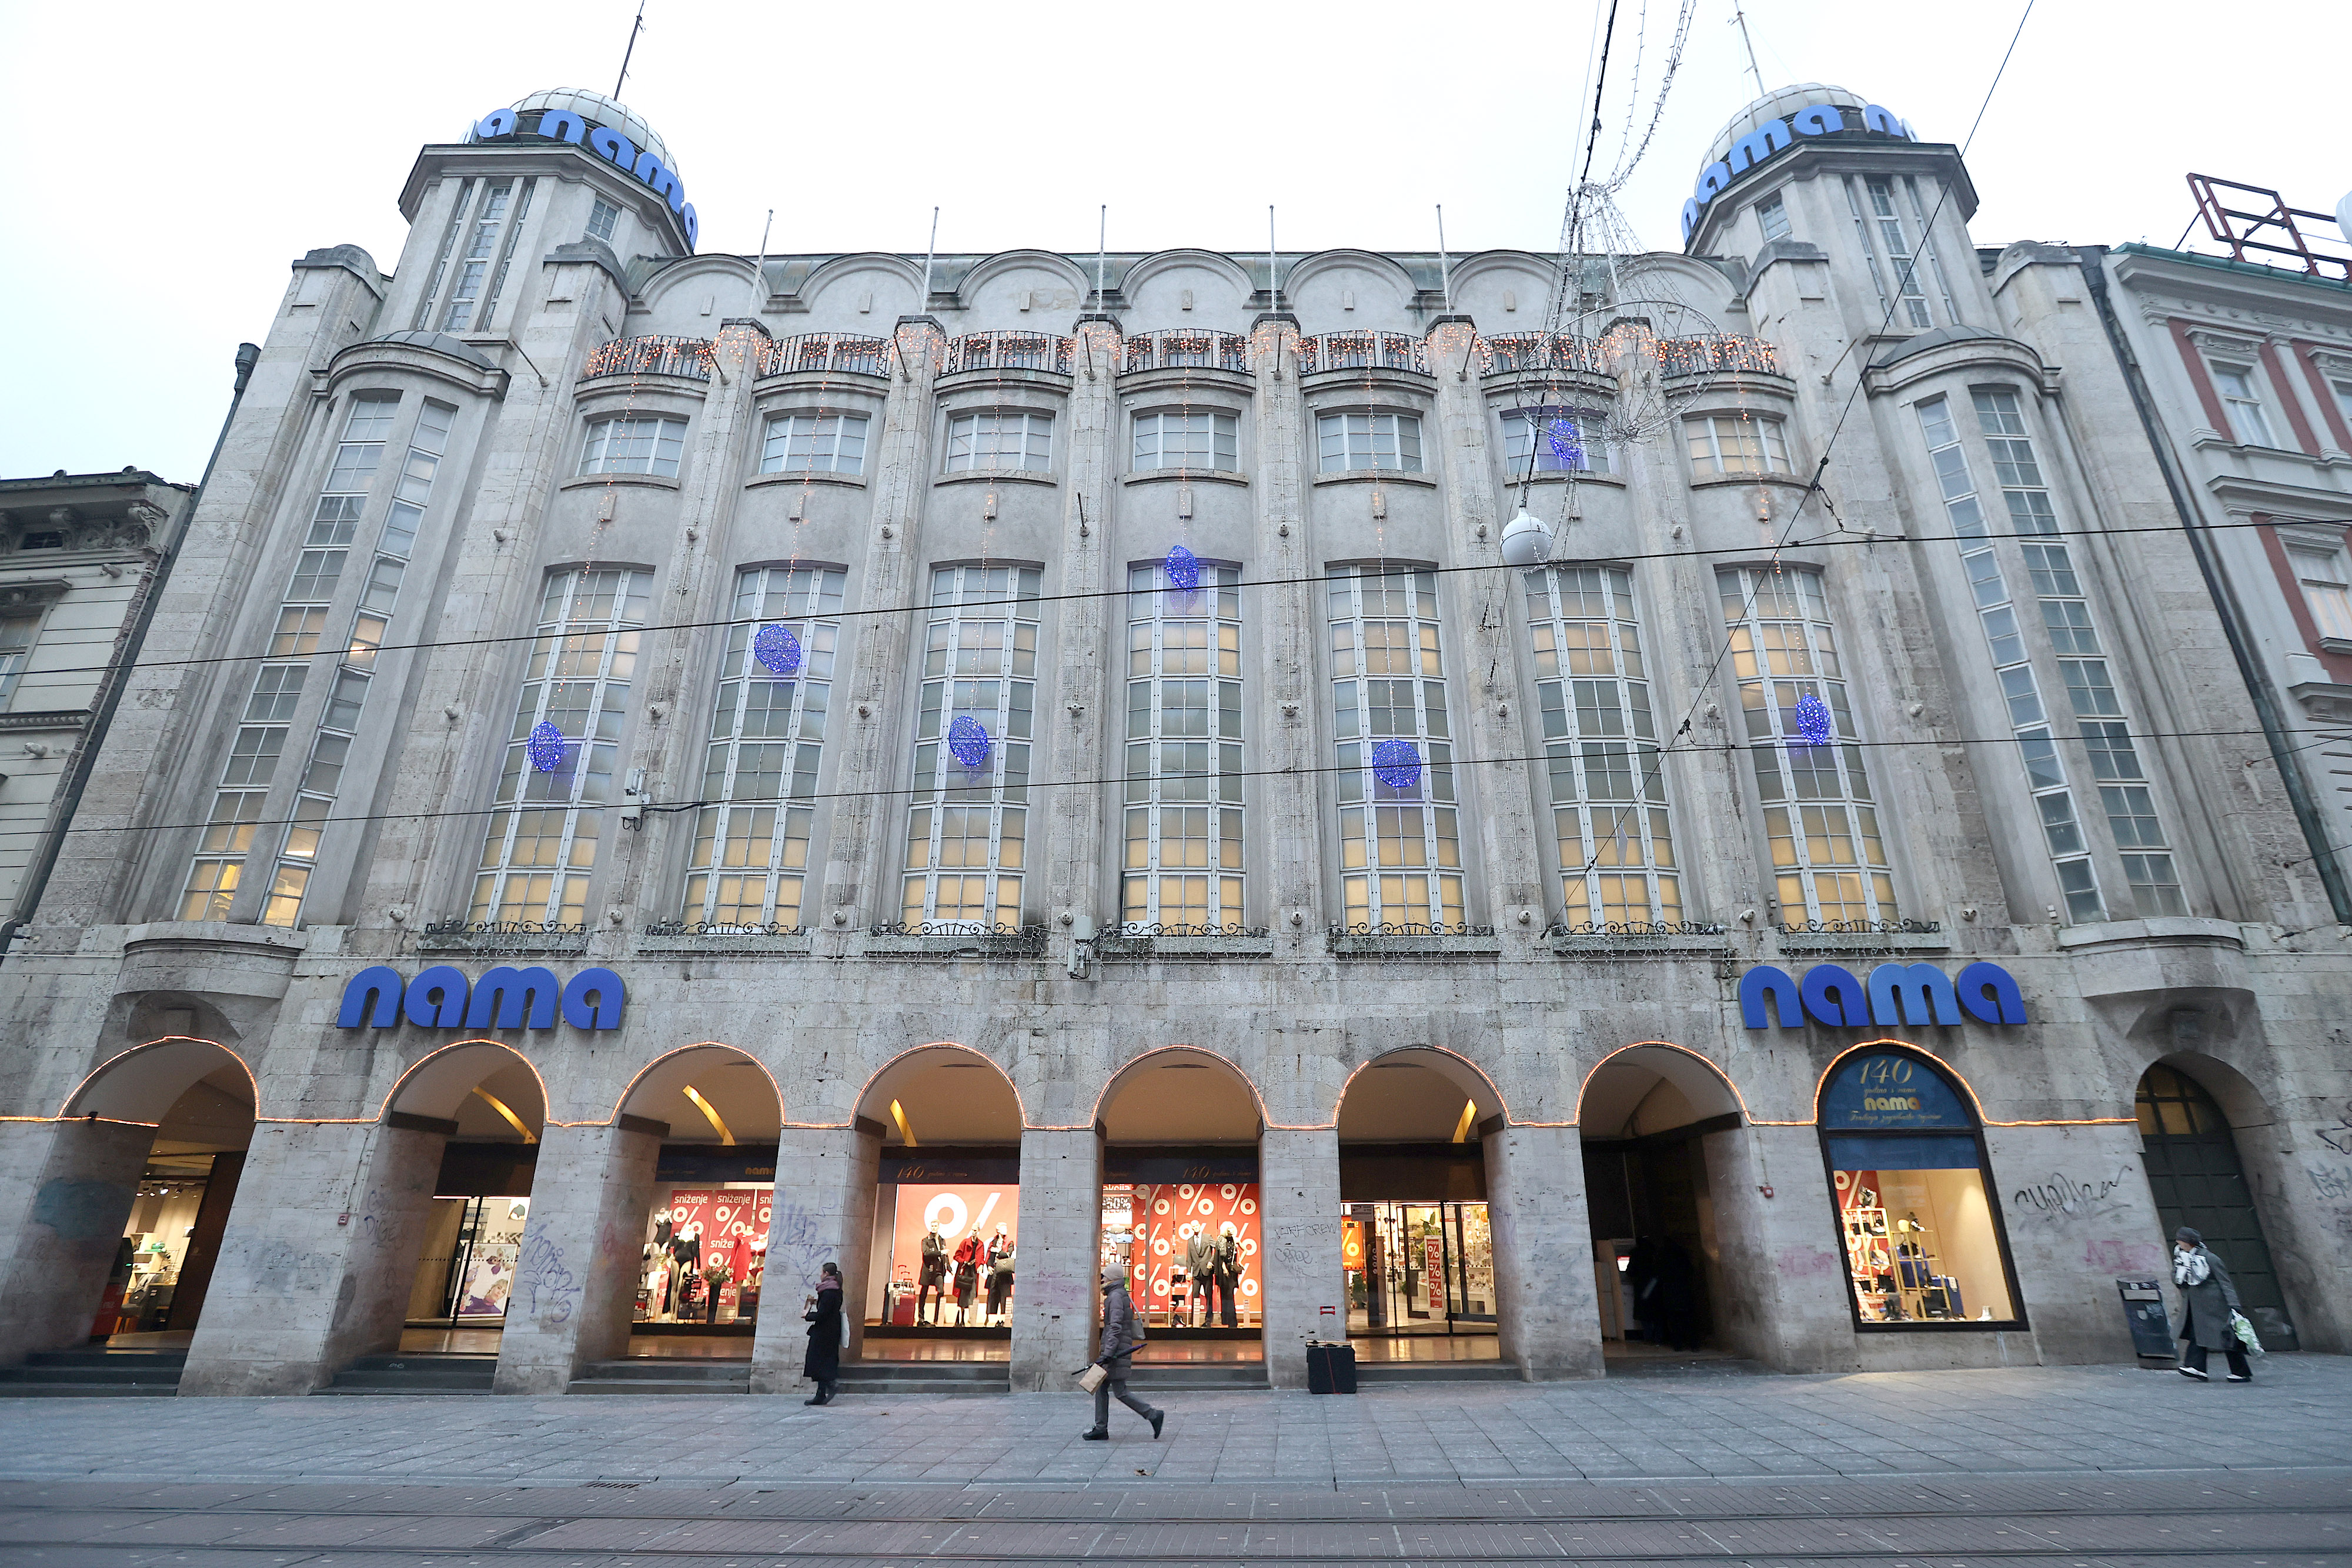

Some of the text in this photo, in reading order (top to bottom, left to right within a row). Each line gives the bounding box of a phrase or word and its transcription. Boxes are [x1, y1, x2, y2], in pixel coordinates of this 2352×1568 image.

[537, 109, 698, 250] nama
[336, 965, 625, 1029] nama
[1739, 962, 2027, 1029] nama
[1860, 1059, 1913, 1084] 140
[1863, 1096, 1921, 1111] nama
[897, 1166, 924, 1179] 140
[674, 1195, 708, 1205] sniženje
[717, 1194, 751, 1204] sniženje
